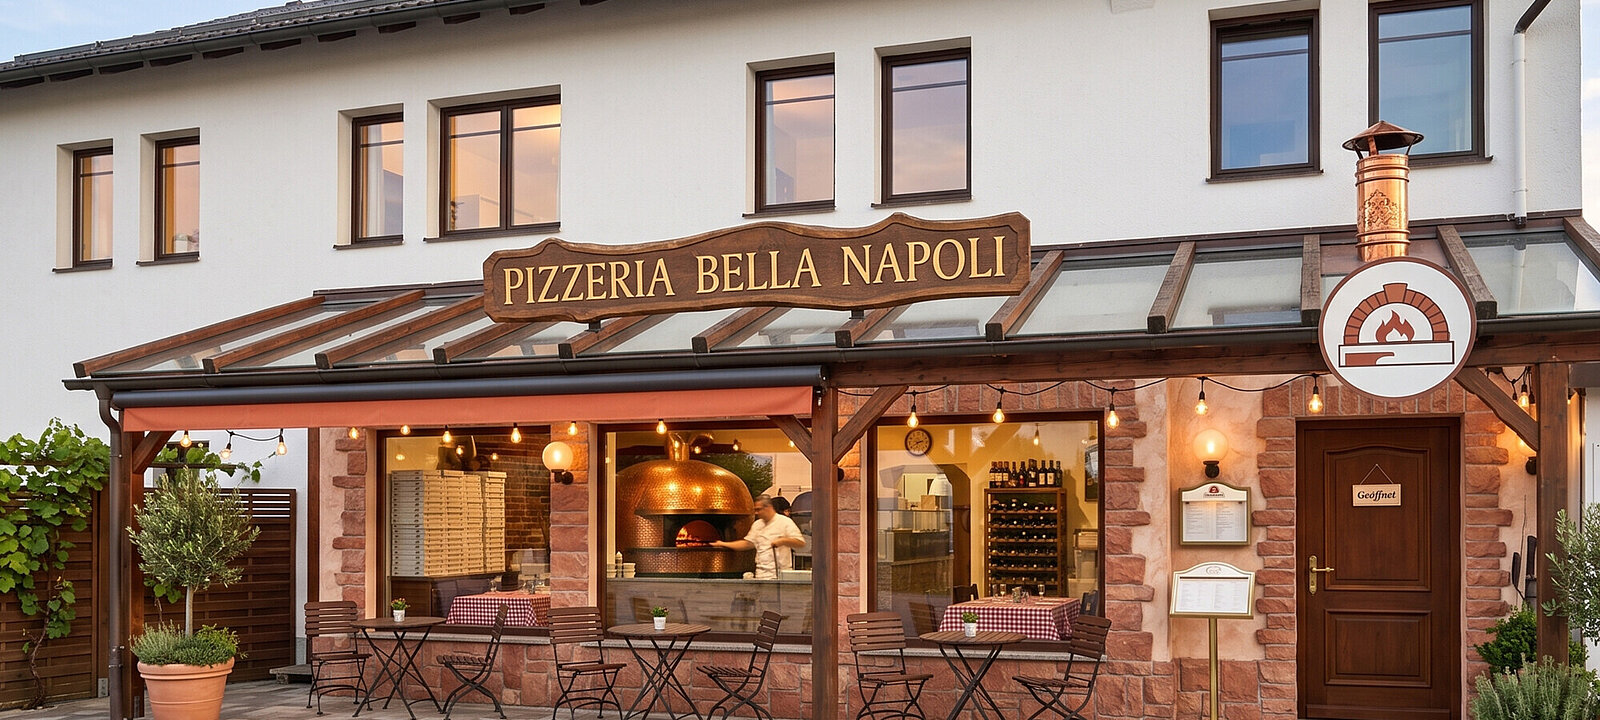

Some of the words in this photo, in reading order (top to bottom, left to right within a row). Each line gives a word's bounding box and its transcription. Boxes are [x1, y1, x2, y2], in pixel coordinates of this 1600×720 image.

[502, 257, 675, 306] PIZZERIA
[695, 247, 822, 294] BELLA
[841, 235, 1007, 287] NAPOLI
